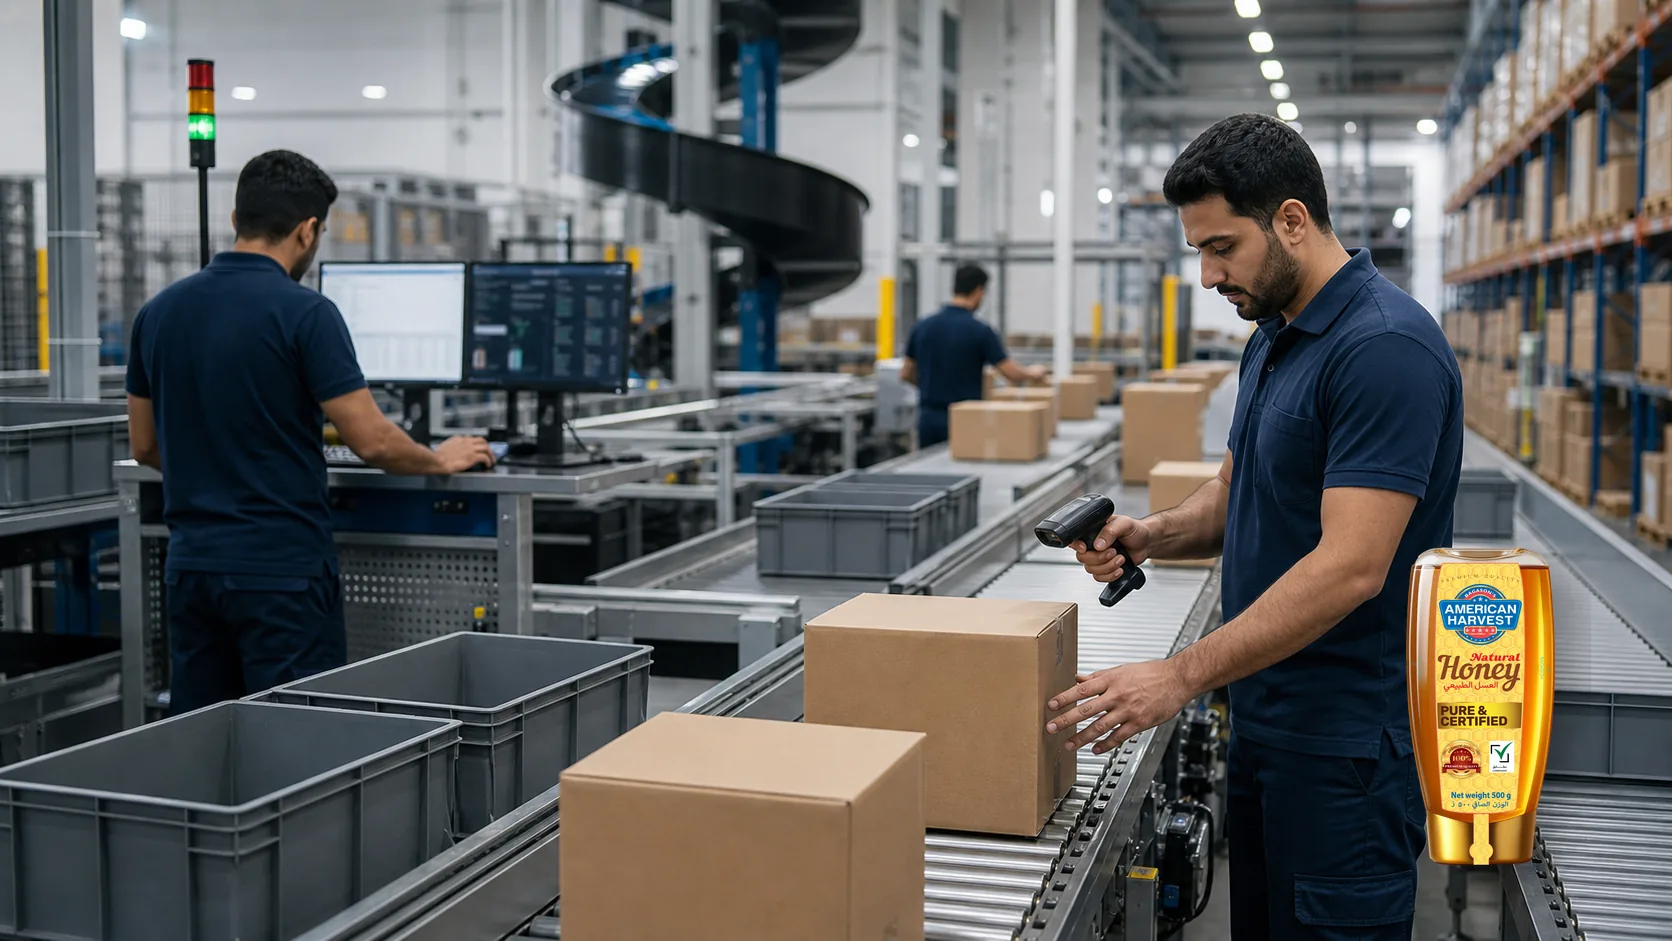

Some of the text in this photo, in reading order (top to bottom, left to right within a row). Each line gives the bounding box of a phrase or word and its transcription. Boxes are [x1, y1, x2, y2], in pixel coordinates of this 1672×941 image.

[1444, 604, 1517, 614] AMERICAN
[1447, 615, 1514, 626] HARVEST
[1469, 652, 1521, 662] Natural
[1437, 654, 1521, 692] Honey
[1443, 681, 1499, 693] العسل الطبيعي
[1440, 705, 1488, 716] PURE &
[1440, 716, 1508, 727] CERTIFIED
[1450, 791, 1512, 801] Net weight 500 g
